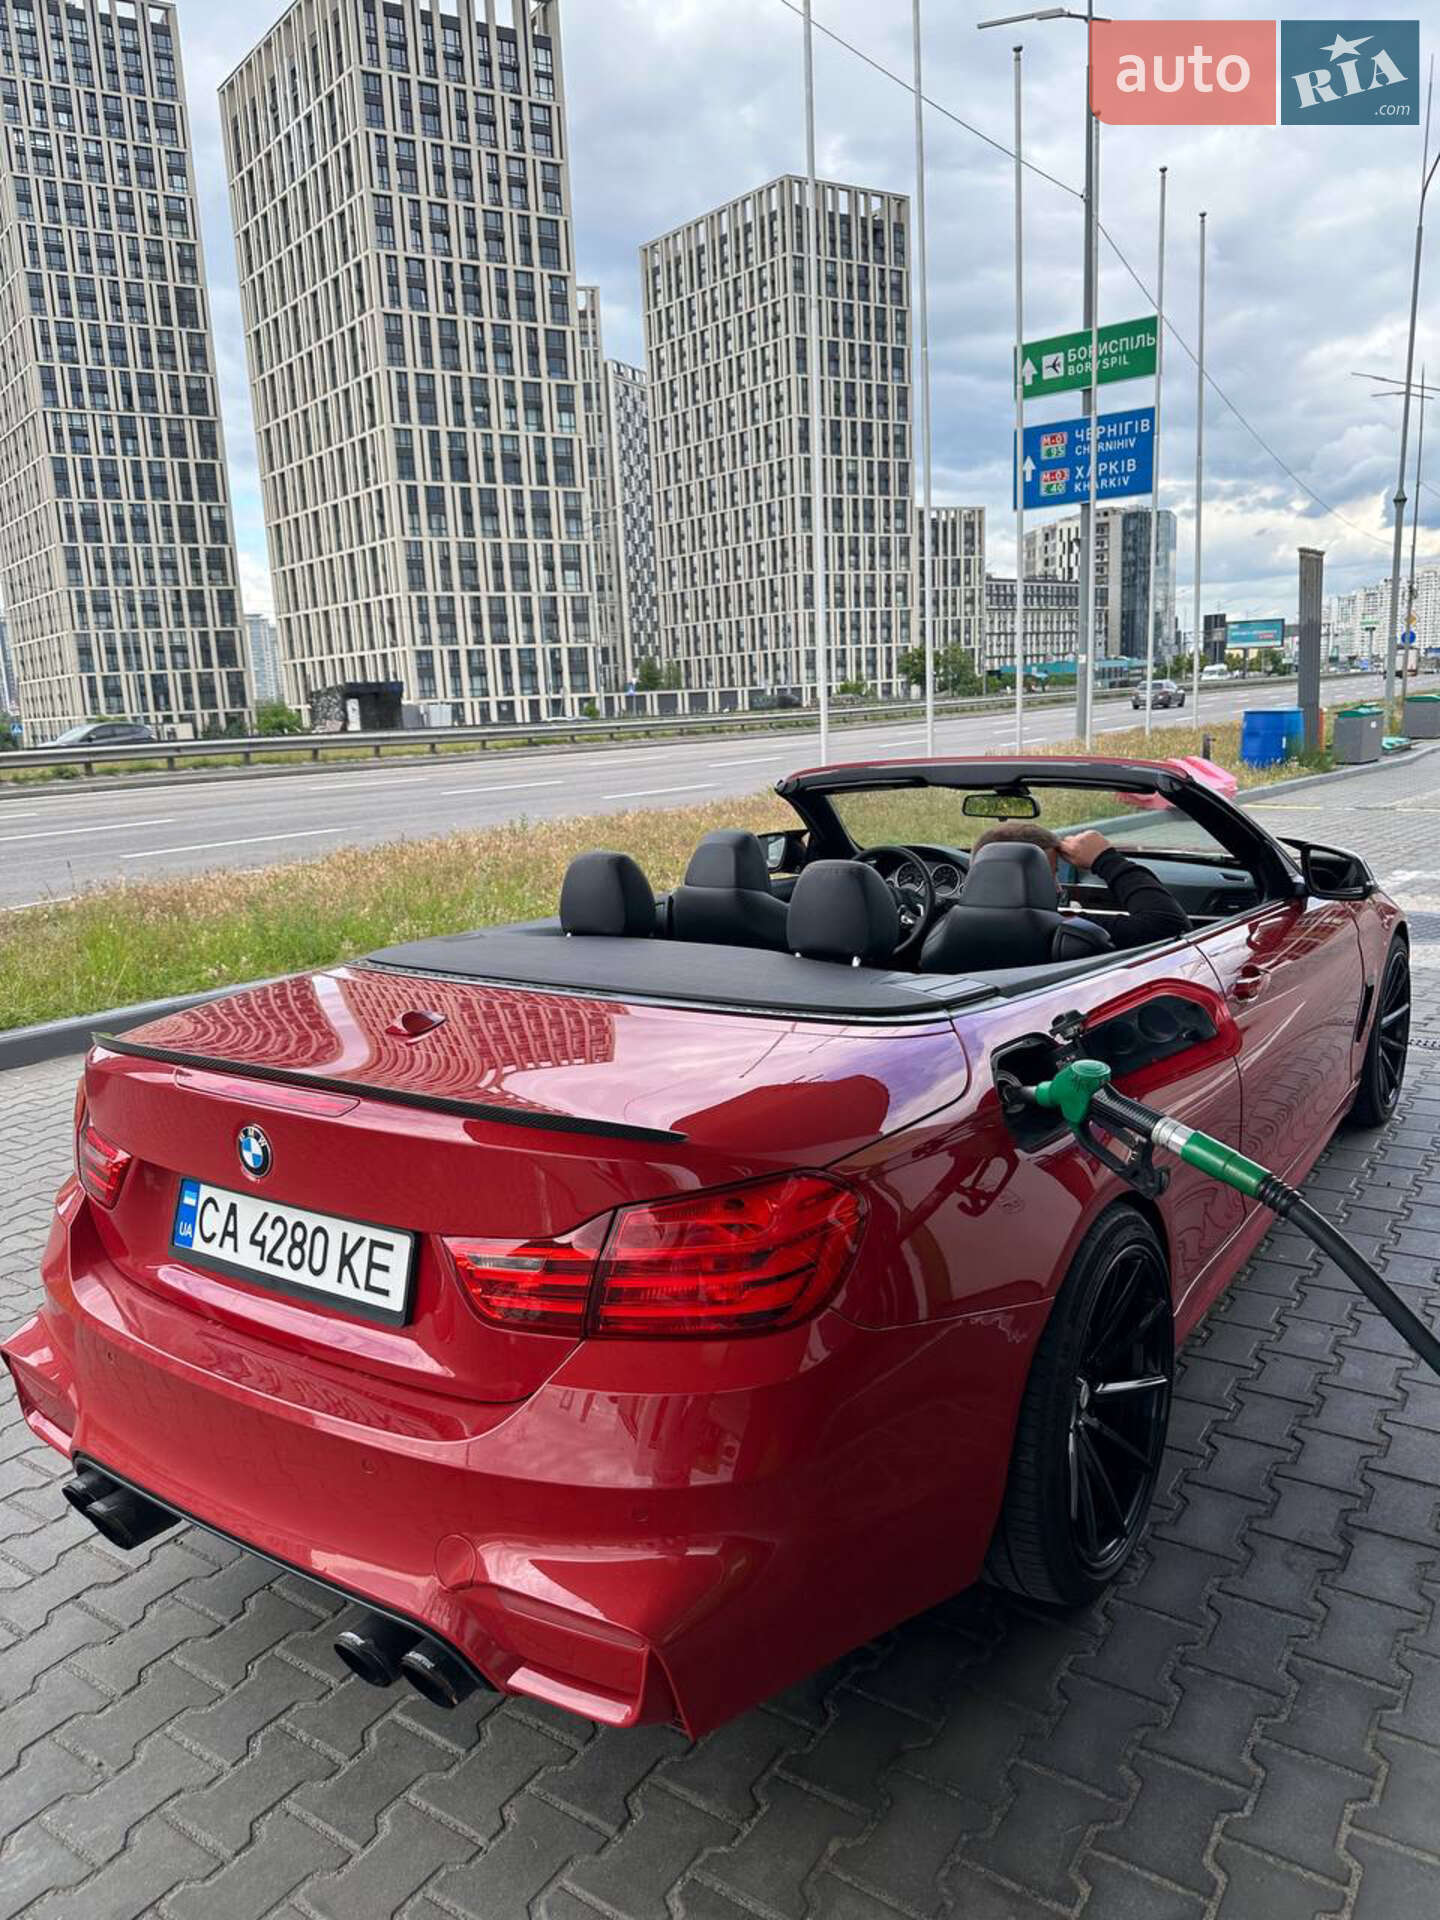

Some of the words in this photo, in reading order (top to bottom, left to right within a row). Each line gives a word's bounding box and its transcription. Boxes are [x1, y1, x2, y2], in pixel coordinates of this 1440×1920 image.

[1075, 418, 1151, 442] ЧЕРНІГІВ
[1075, 436, 1136, 456] CHRNIHIV
[179, 1221, 193, 1238] UA
[198, 1196, 239, 1253] CA
[249, 1211, 329, 1277] 4280
[336, 1231, 394, 1296] KE
